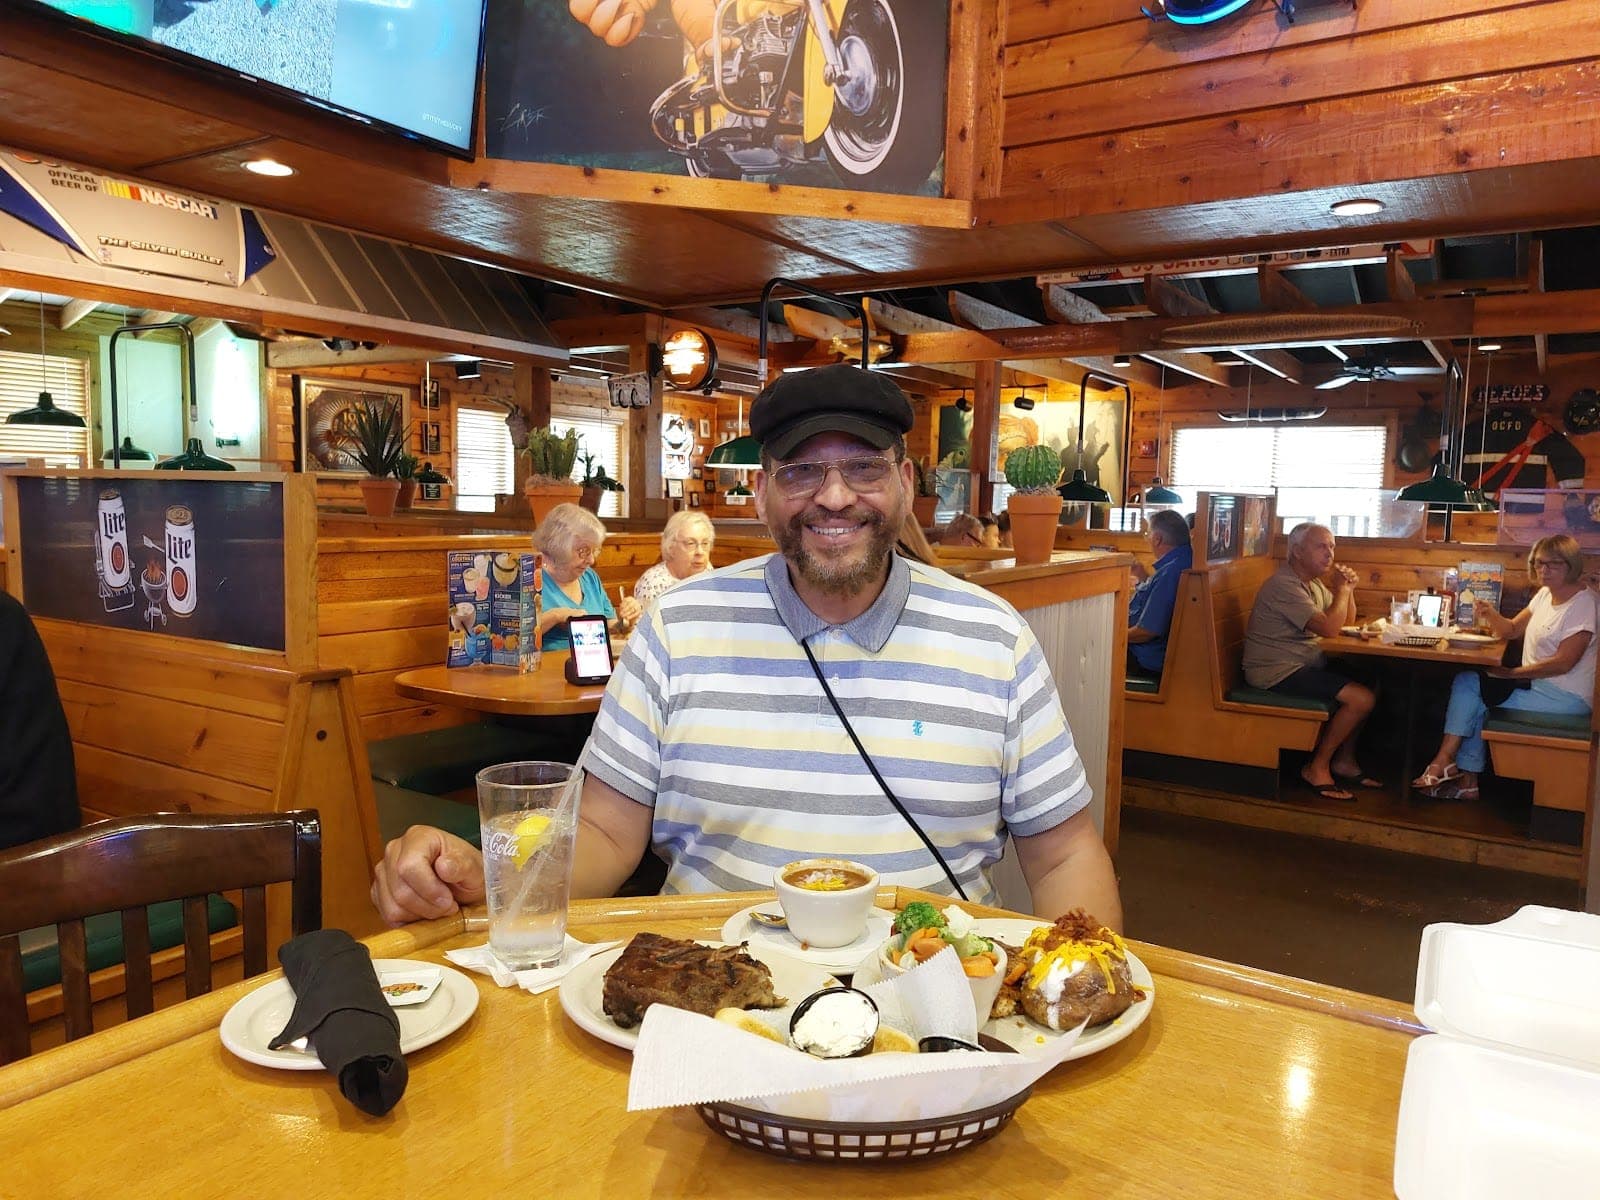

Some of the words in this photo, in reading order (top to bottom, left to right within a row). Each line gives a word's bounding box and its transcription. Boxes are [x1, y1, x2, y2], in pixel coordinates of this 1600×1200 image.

[48, 169, 97, 184] OFFICIAL
[51, 178, 81, 190] BEER
[84, 184, 99, 192] OF
[138, 188, 215, 220] NASCAR
[97, 236, 128, 248] THE
[129, 240, 177, 256] SILVER
[180, 248, 224, 266] BULLET
[102, 511, 125, 539] Lite
[167, 534, 192, 565] Lite
